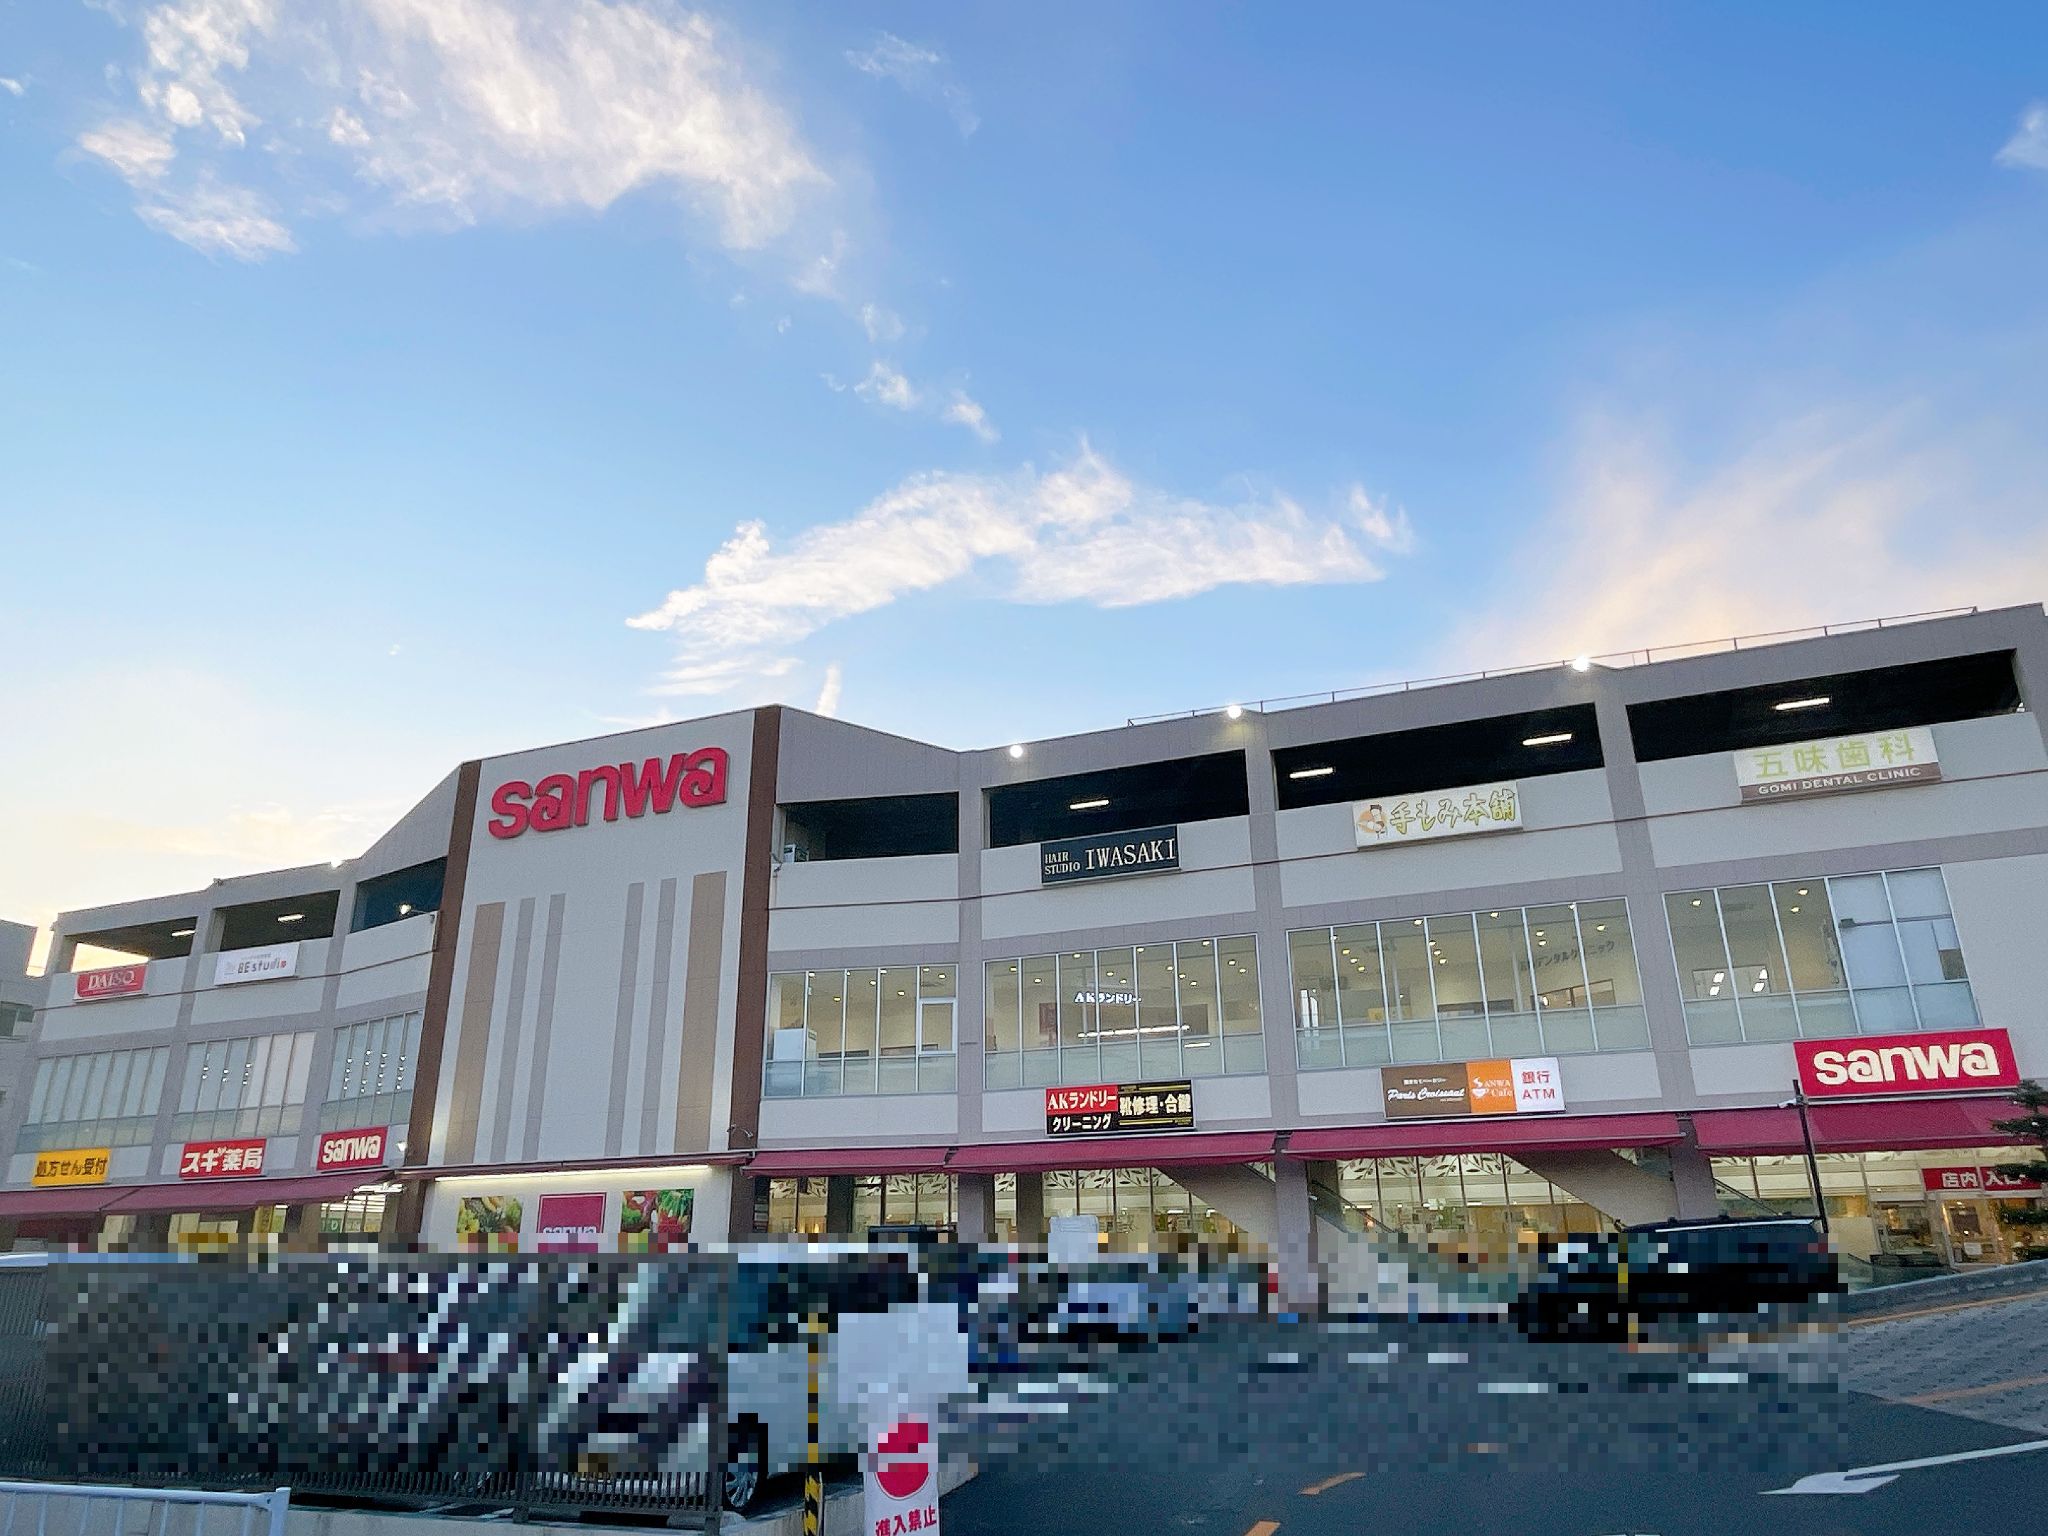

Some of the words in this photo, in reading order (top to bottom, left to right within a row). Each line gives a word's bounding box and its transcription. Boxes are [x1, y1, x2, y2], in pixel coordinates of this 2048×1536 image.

[1753, 732, 1915, 778] 五味歯科
[488, 747, 730, 839] sanwa
[1758, 782, 1798, 795] GOMI
[1802, 775, 1863, 790] DENTAL
[1867, 767, 1921, 781] CLINIC
[1390, 788, 1516, 834] 手もみ本舗
[1044, 851, 1069, 864] HAIR
[1085, 838, 1175, 870] IWASAKI
[1044, 861, 1081, 875] STUDIO
[88, 970, 135, 989] DAISO
[1522, 1070, 1550, 1084] 銀行
[1813, 1042, 2000, 1086] sanwa
[1047, 1090, 1117, 1110] AKランドリー
[1522, 1088, 1556, 1100] ATM
[1053, 1113, 1112, 1132] クリーニング
[181, 1146, 264, 1173] スギ薬局
[322, 1134, 380, 1164] sanwa
[875, 1503, 937, 1536] 進入禁止
